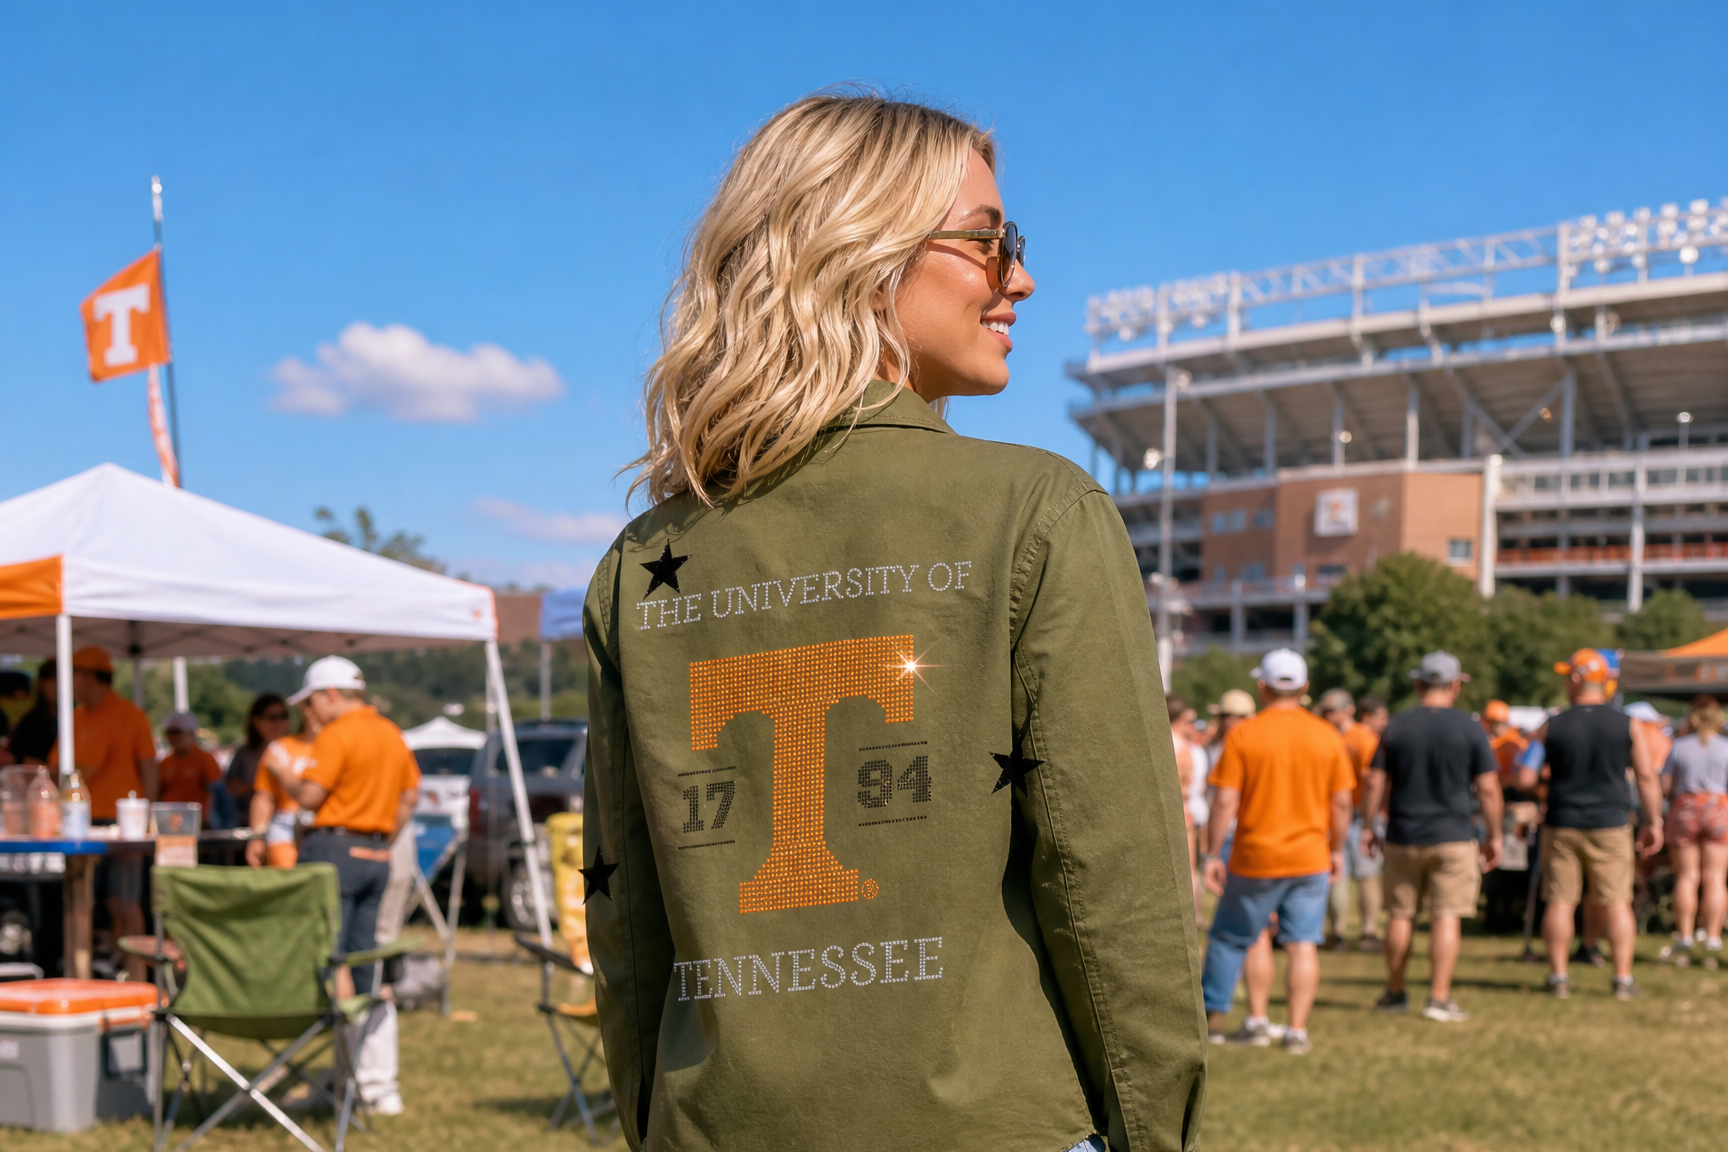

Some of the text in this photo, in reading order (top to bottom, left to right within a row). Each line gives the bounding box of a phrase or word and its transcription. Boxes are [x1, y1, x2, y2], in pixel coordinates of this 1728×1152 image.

[93, 282, 150, 368] T
[636, 560, 973, 631] THE UNIVERSITY OF
[682, 755, 932, 834] 17 94
[673, 936, 943, 1001] TENNESSEE
